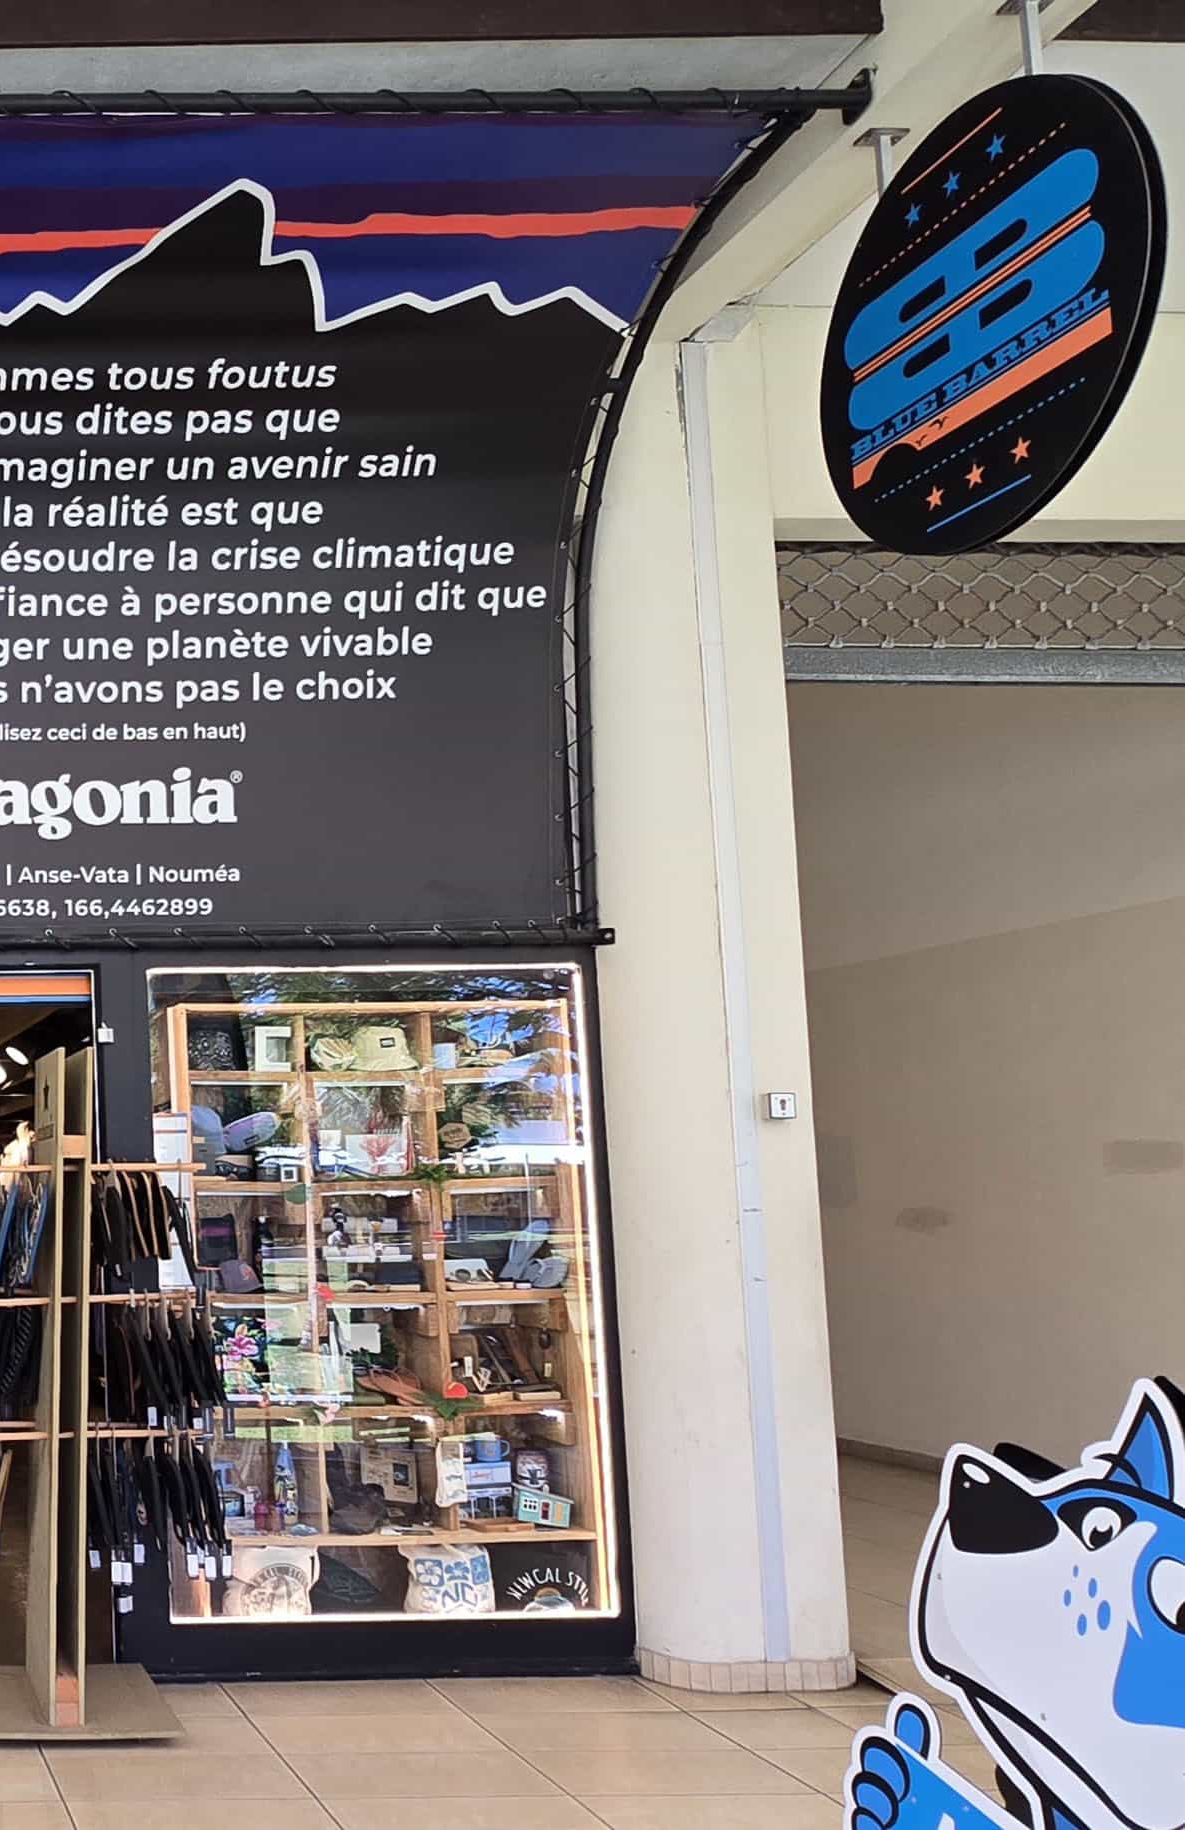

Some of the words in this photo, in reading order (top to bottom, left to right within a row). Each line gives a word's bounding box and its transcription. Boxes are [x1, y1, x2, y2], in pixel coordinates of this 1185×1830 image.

[108, 363, 194, 390] tous
[208, 358, 336, 388] foutus
[852, 393, 936, 460] BLUE
[943, 289, 1110, 400] BARREL
[76, 403, 172, 434] dites
[186, 410, 252, 441] pas
[266, 409, 340, 440] que
[167, 457, 214, 480] un
[228, 447, 349, 479] avenir
[359, 446, 436, 477] sain
[4, 496, 33, 527] la
[49, 495, 168, 527] réalité
[182, 498, 238, 525] est
[251, 501, 323, 531] que
[168, 541, 197, 571] la
[212, 539, 300, 570] crise
[313, 536, 514, 573] climatique
[121, 586, 140, 616] à
[155, 591, 332, 622] personne
[344, 581, 403, 619] qui
[416, 580, 465, 611] dit
[478, 586, 546, 616] que
[63, 638, 133, 660] une
[147, 629, 288, 666] planète
[300, 626, 432, 656] vivable
[177, 680, 239, 709] pas
[253, 672, 284, 701] le
[296, 669, 396, 700] choix
[0, 723, 42, 741] lisez
[47, 723, 86, 740] ceci
[92, 723, 118, 740] de
[123, 723, 158, 740] bas
[163, 727, 188, 739] en
[194, 722, 246, 742] haut)
[18, 866, 129, 884] Anse-Vata
[149, 864, 240, 883] Nouméa
[64, 898, 213, 919] 166,4462899
